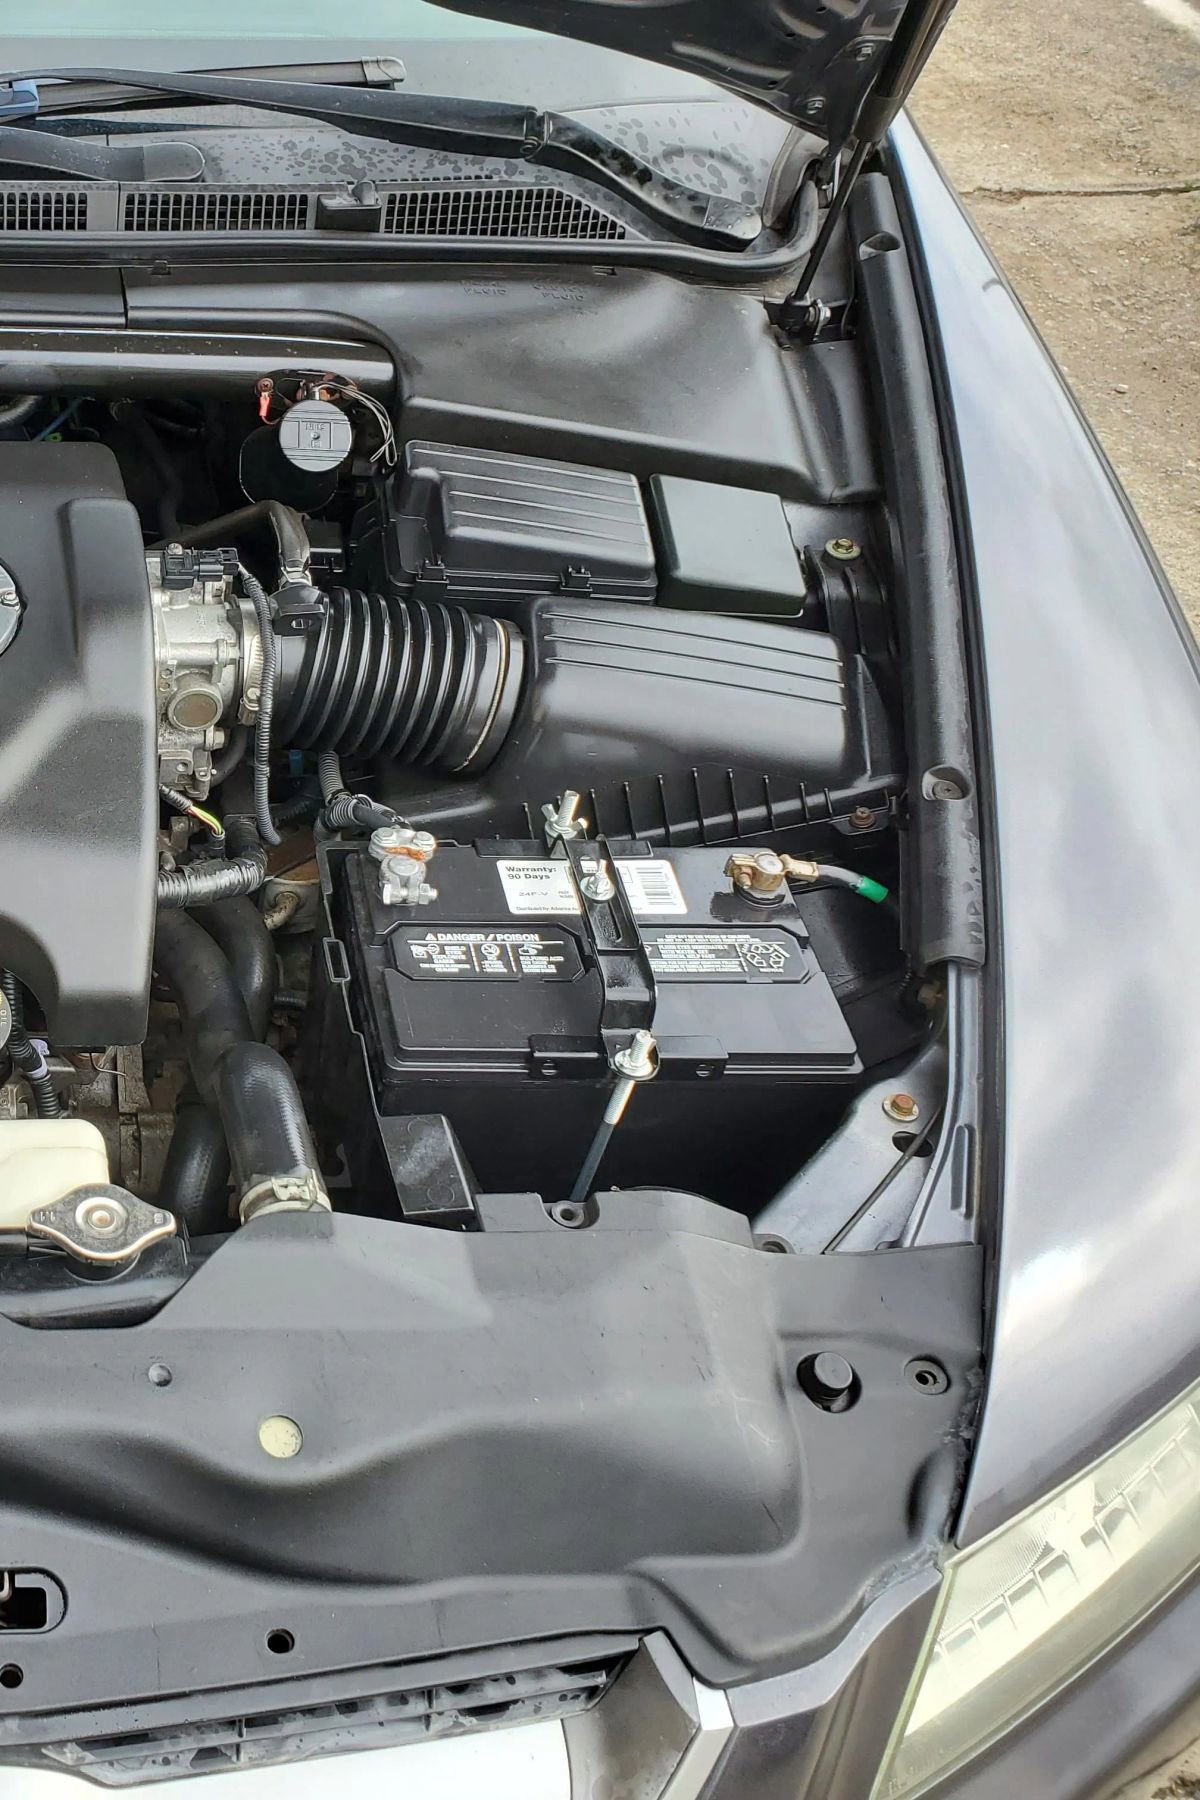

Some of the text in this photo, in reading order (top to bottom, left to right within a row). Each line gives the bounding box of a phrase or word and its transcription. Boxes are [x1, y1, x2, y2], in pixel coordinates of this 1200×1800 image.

[505, 865, 557, 873] Warranty:
[437, 933, 486, 941] DANGER
[496, 933, 540, 941] POISON
[0, 1009, 8, 1026] OIL
